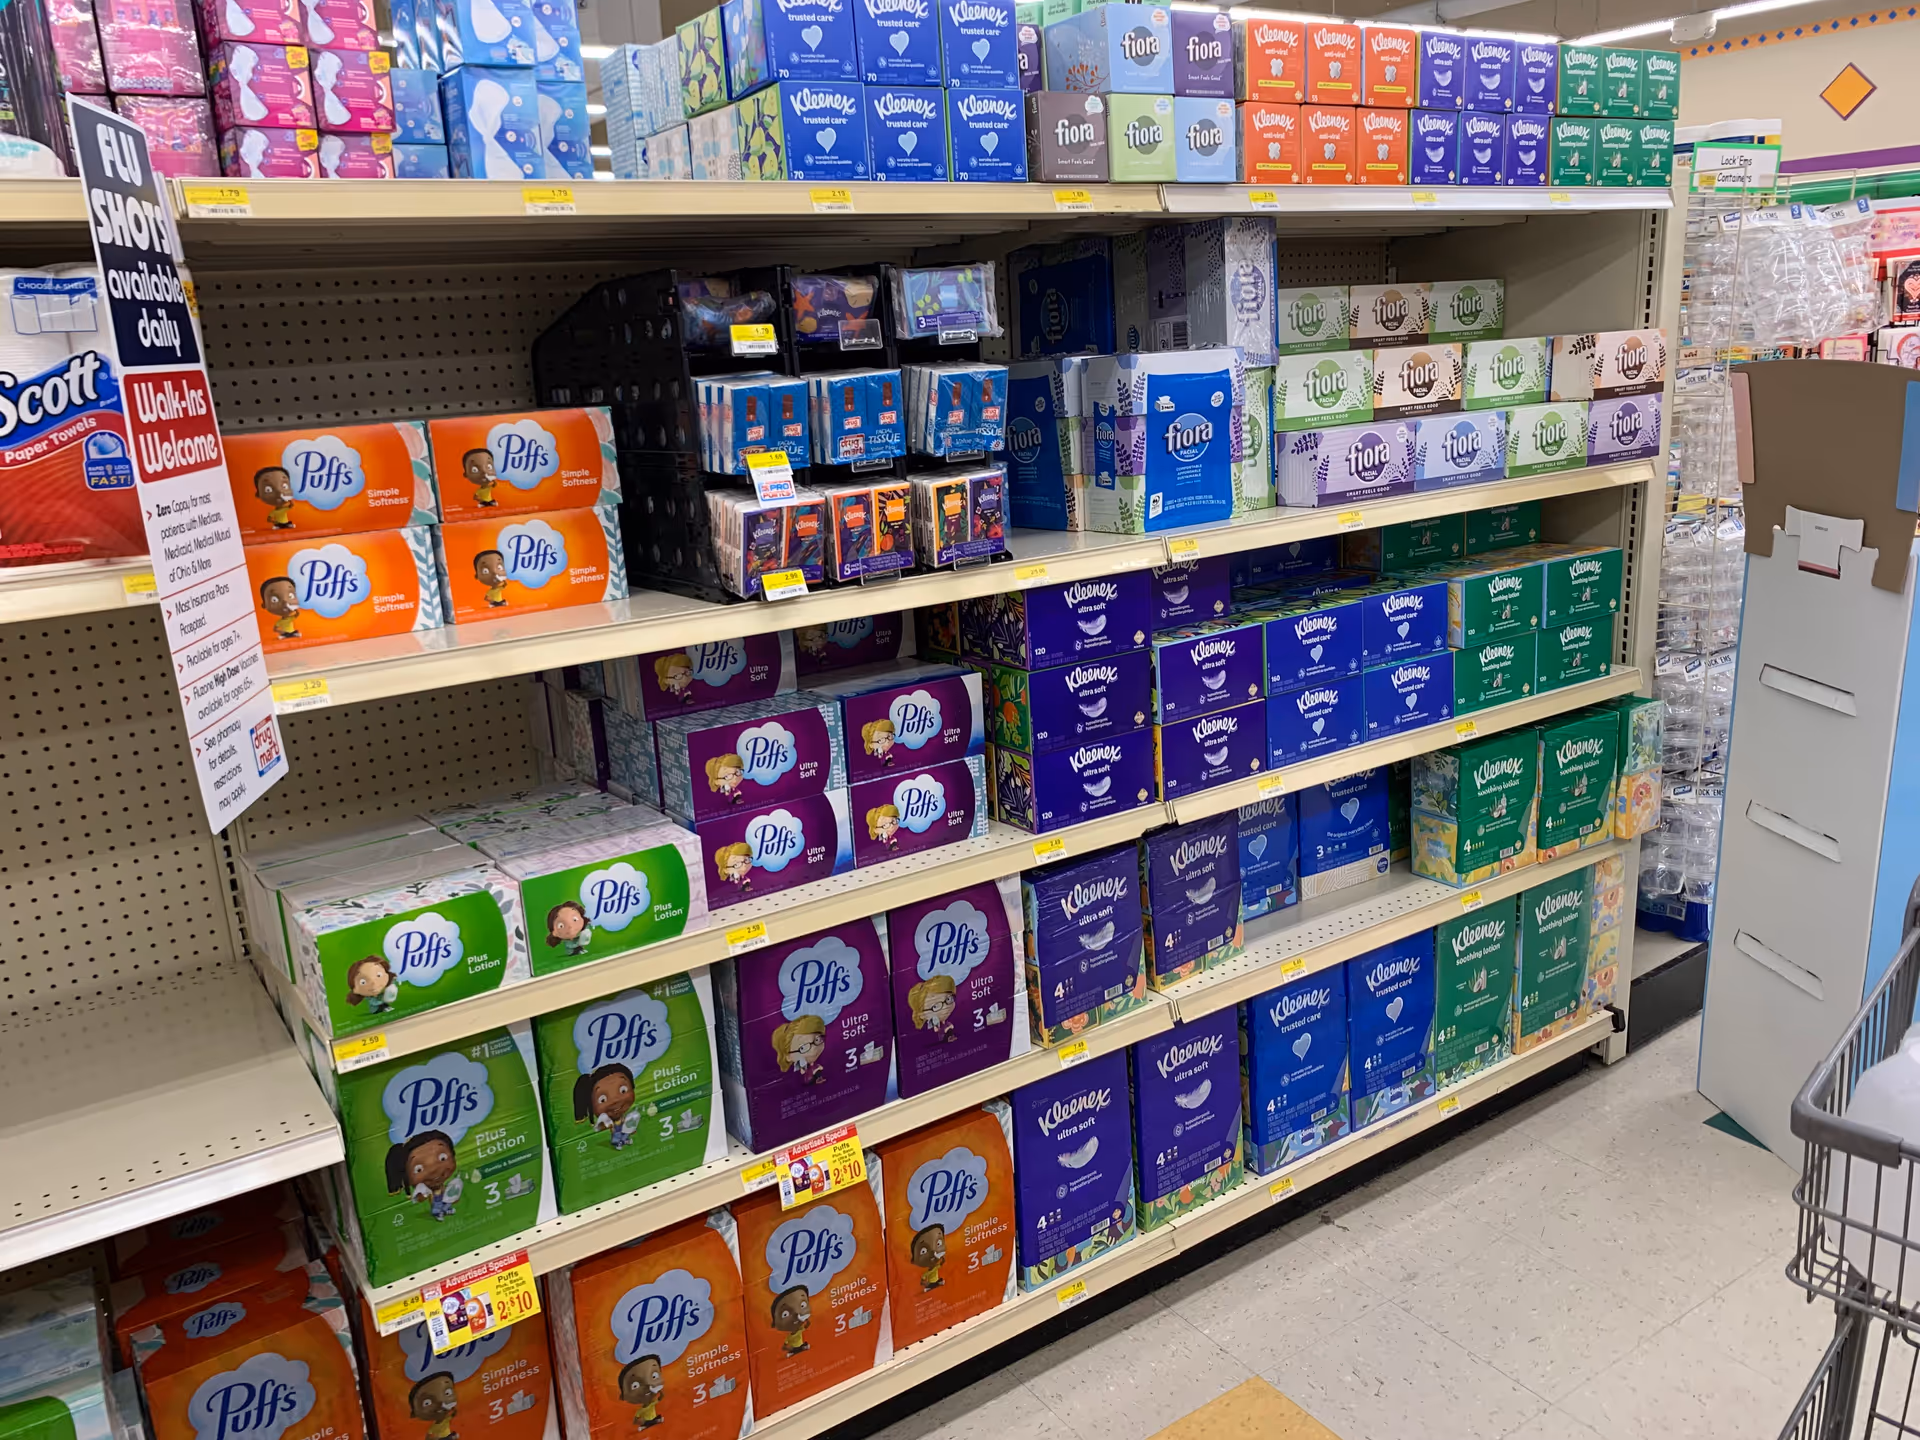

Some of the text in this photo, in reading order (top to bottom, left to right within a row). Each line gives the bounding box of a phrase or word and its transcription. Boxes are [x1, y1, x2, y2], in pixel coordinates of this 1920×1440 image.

[1122, 33, 1160, 60] fiora
[1187, 36, 1222, 61] fiora
[1371, 32, 1411, 55] Kleenex
[1425, 36, 1462, 59] Kleenex
[1605, 53, 1638, 72] Kleenex
[790, 88, 857, 116] Kleenex
[803, 117, 847, 126] trusted care
[1055, 119, 1094, 147] fiora
[1125, 121, 1163, 149] fiora
[96, 123, 143, 187] FLU
[794, 171, 804, 180] 70
[1716, 172, 1753, 183] Containes
[220, 189, 241, 197] 1.79
[551, 189, 568, 197] 1.79
[1859, 199, 1867, 210] 3
[90, 188, 171, 255] SHOTS
[107, 261, 184, 304] available
[138, 308, 182, 357] daily
[919, 316, 926, 328] 3
[1399, 360, 1440, 391] fiora
[1490, 353, 1526, 382] fiora
[0, 352, 100, 437] Scott
[1303, 366, 1348, 401] fiora
[133, 378, 207, 424] Walk-Ins
[4, 417, 97, 463] Paper Towels
[840, 439, 860, 451] drug
[868, 433, 901, 444] TISSUE
[1163, 420, 1213, 454] fiora
[1442, 429, 1482, 460] fiora
[139, 430, 218, 476] Welcome
[497, 433, 549, 474] Puffs
[1346, 441, 1390, 477] fiora
[91, 475, 131, 487] FAST!
[561, 468, 590, 478] Simple
[562, 476, 599, 487] Softness
[156, 503, 172, 518] Zero
[190, 495, 198, 508] for
[161, 522, 186, 544] patients
[176, 564, 192, 580] Ohio
[197, 558, 212, 571] More
[1064, 580, 1118, 608] Kleenex
[1488, 575, 1523, 597] Kleenex
[1491, 593, 1507, 602] soothing
[175, 600, 191, 616] Most
[1077, 602, 1106, 614] ultra soft
[1294, 615, 1338, 640] Kleenex
[186, 647, 213, 669] Available
[220, 637, 233, 653] ages
[1035, 647, 1046, 655] 120
[214, 672, 227, 688] High
[226, 664, 240, 680] Dose
[198, 694, 223, 720] available
[222, 691, 231, 705] for
[231, 685, 244, 702] ages
[204, 735, 217, 752] See
[254, 727, 273, 750] drug
[208, 755, 219, 770] for
[260, 742, 281, 768] mart
[745, 735, 789, 774] Puffs
[799, 761, 818, 771] Ultra
[214, 763, 242, 792] restrictions
[800, 768, 817, 779] Soft
[1474, 757, 1523, 789] Kleenex
[1477, 778, 1520, 798] soothing lotion
[219, 793, 231, 811] may
[755, 823, 797, 863] Puffs
[807, 846, 826, 856] Ultra
[1464, 839, 1471, 853] 4
[808, 853, 824, 864] Soft
[1061, 876, 1127, 920] Kleenex
[1079, 905, 1114, 927] ultra soft
[395, 931, 452, 974] Puffs
[467, 953, 489, 965] Plus
[468, 959, 502, 975] Lotion
[1365, 955, 1420, 992] Kleenex
[791, 960, 850, 1012] Puffs
[1376, 977, 1412, 998] trusted care
[841, 1012, 870, 1028] Ultra
[842, 1023, 868, 1040] Soft
[361, 1035, 380, 1046] 2.59
[471, 1042, 490, 1059] #1
[845, 1048, 858, 1068] 3
[399, 1076, 478, 1138] Puffs
[1037, 1087, 1111, 1137] Kleenex
[475, 1127, 507, 1146] Plus
[1057, 1115, 1097, 1141] ultra soft
[477, 1134, 527, 1159] Lotion
[792, 1126, 849, 1156] Advertised Special
[833, 1142, 850, 1153] Puffs
[833, 1160, 861, 1185] 2 $10
[483, 1181, 501, 1205] 3
[920, 1168, 978, 1223] Puffs
[780, 1227, 844, 1286] Puffs
[445, 1253, 517, 1289] Advertised Special
[497, 1271, 519, 1284] Puffs
[830, 1276, 867, 1297] Simple
[831, 1283, 878, 1308] Softness
[403, 1295, 420, 1307] 6.49
[497, 1290, 533, 1322] 2 $10
[835, 1313, 846, 1333] 3
